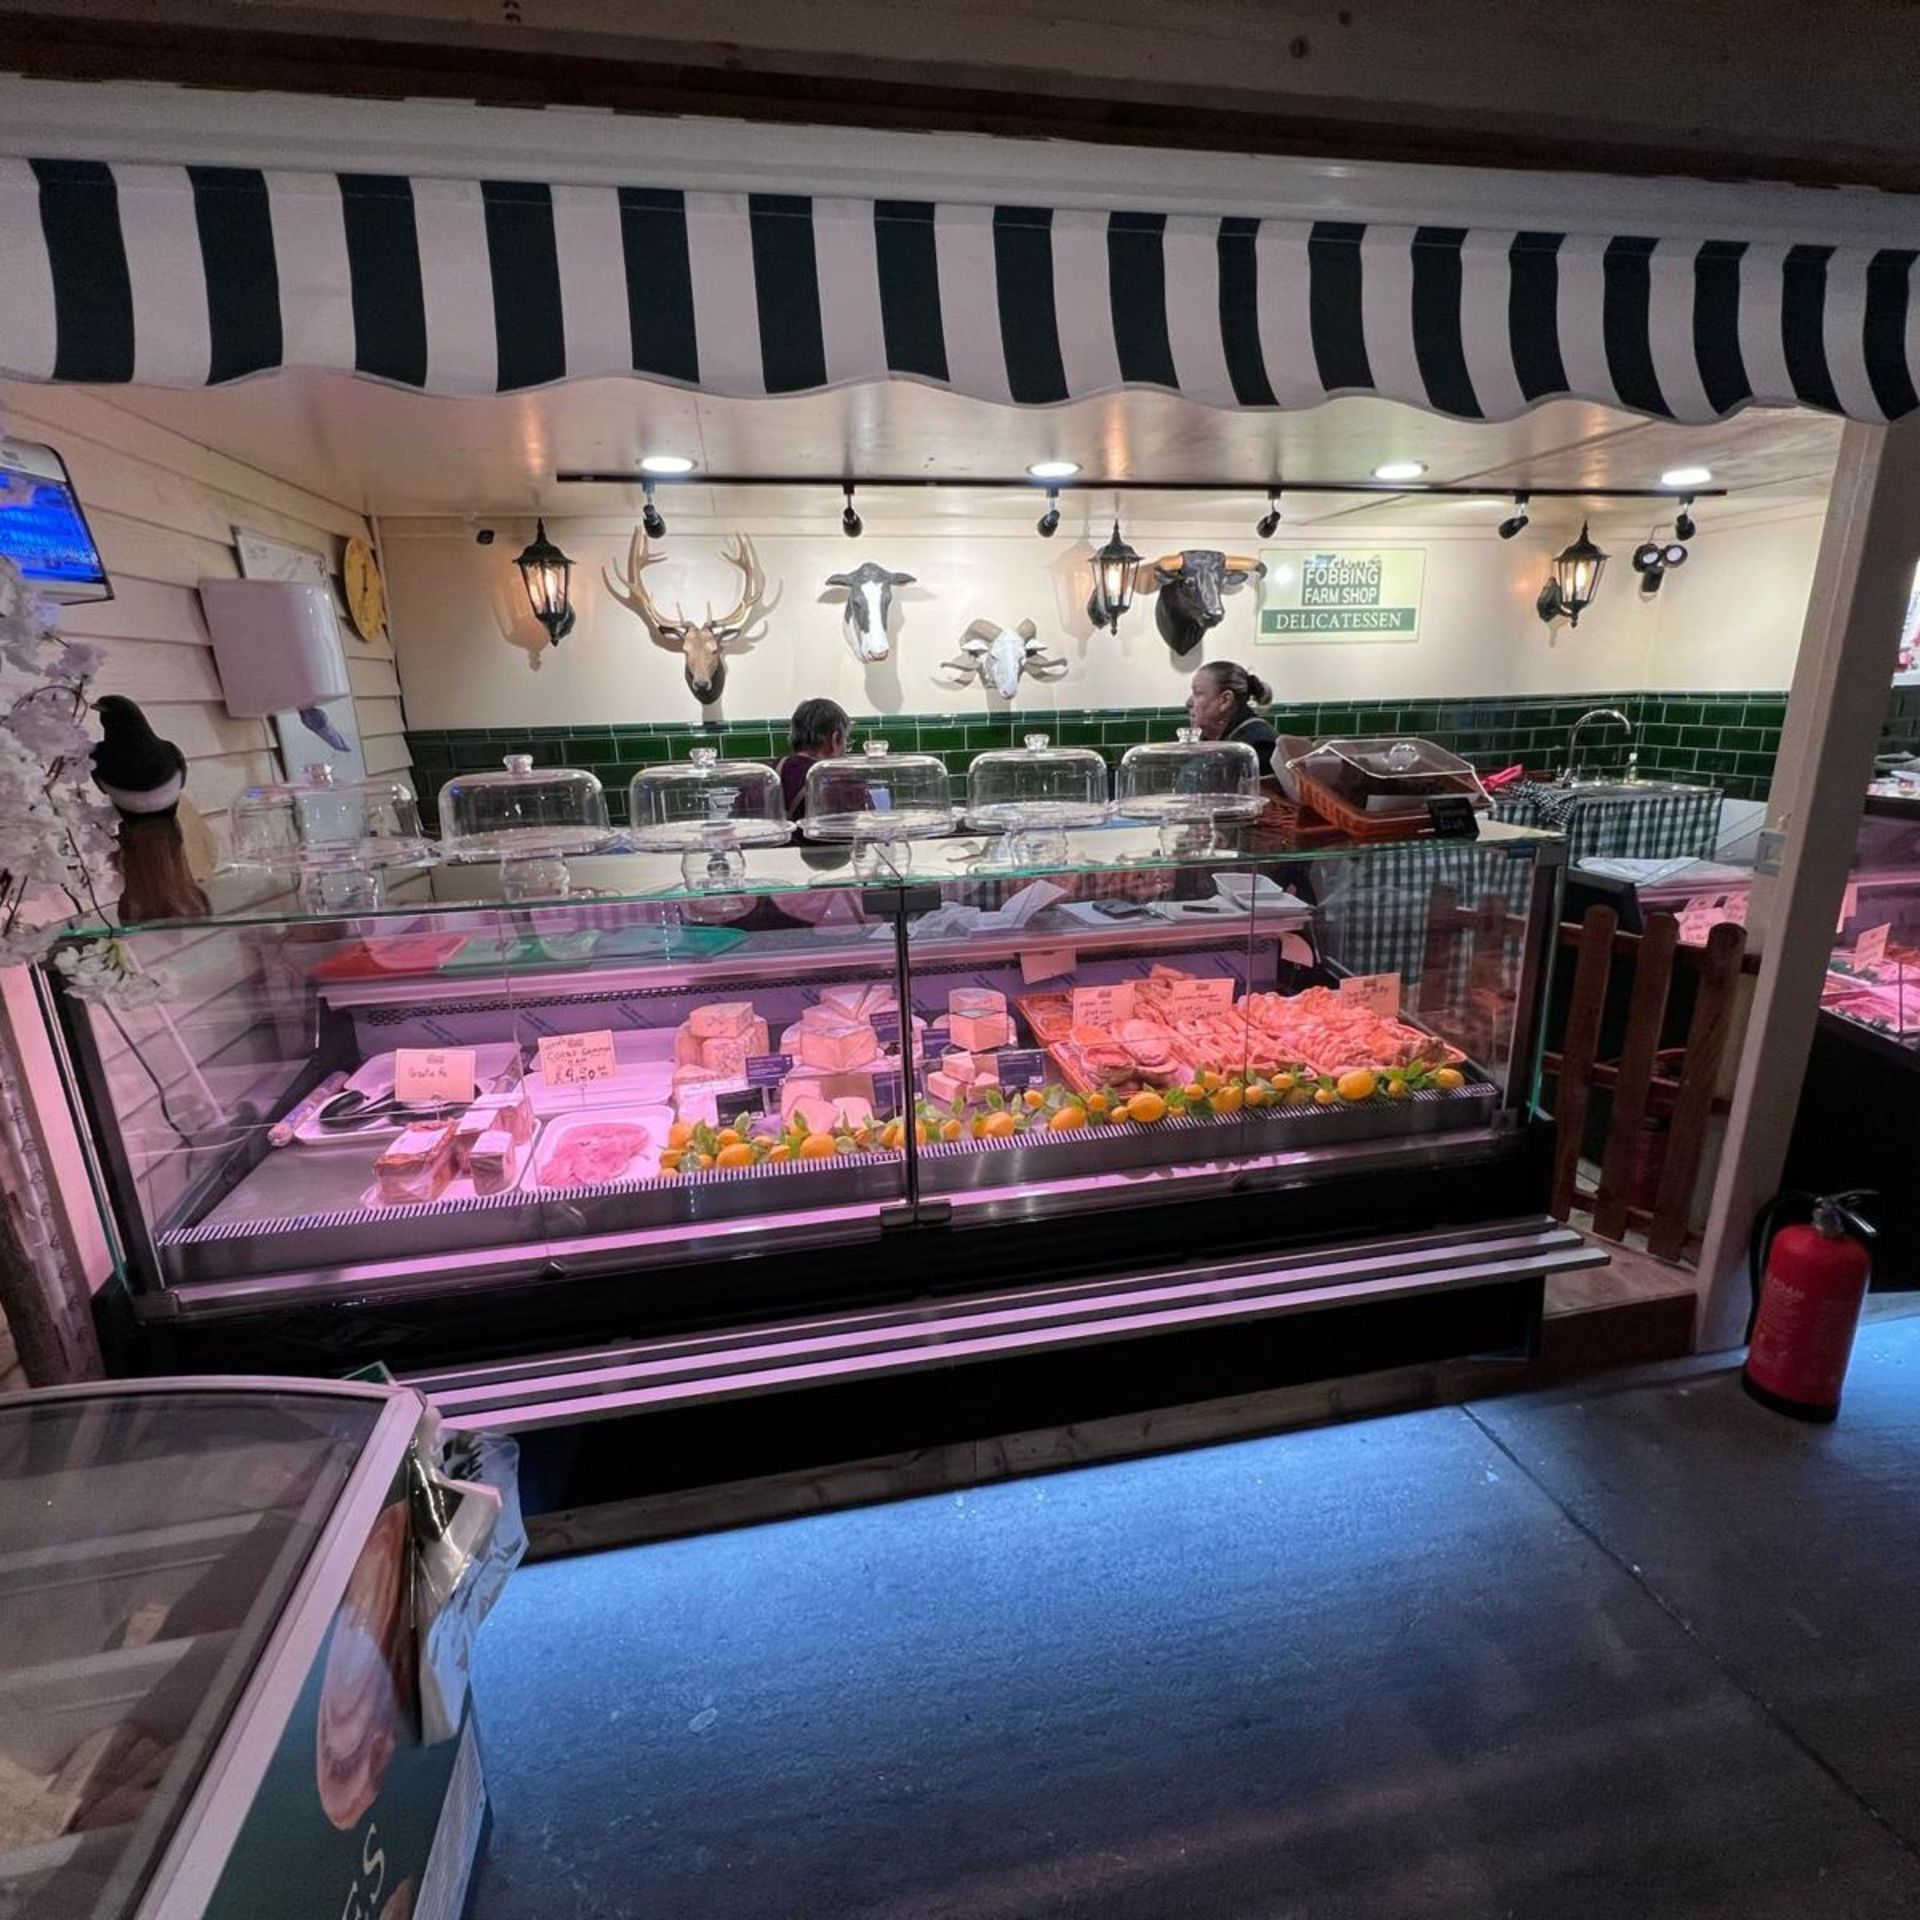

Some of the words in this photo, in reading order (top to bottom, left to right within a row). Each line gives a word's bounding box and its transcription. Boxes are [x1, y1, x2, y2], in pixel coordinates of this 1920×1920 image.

[1305, 568, 1379, 586] FOBBING
[1304, 587, 1340, 604] FARM
[1342, 587, 1377, 604] SHOP
[1275, 612, 1403, 630] DELICATESSEN
